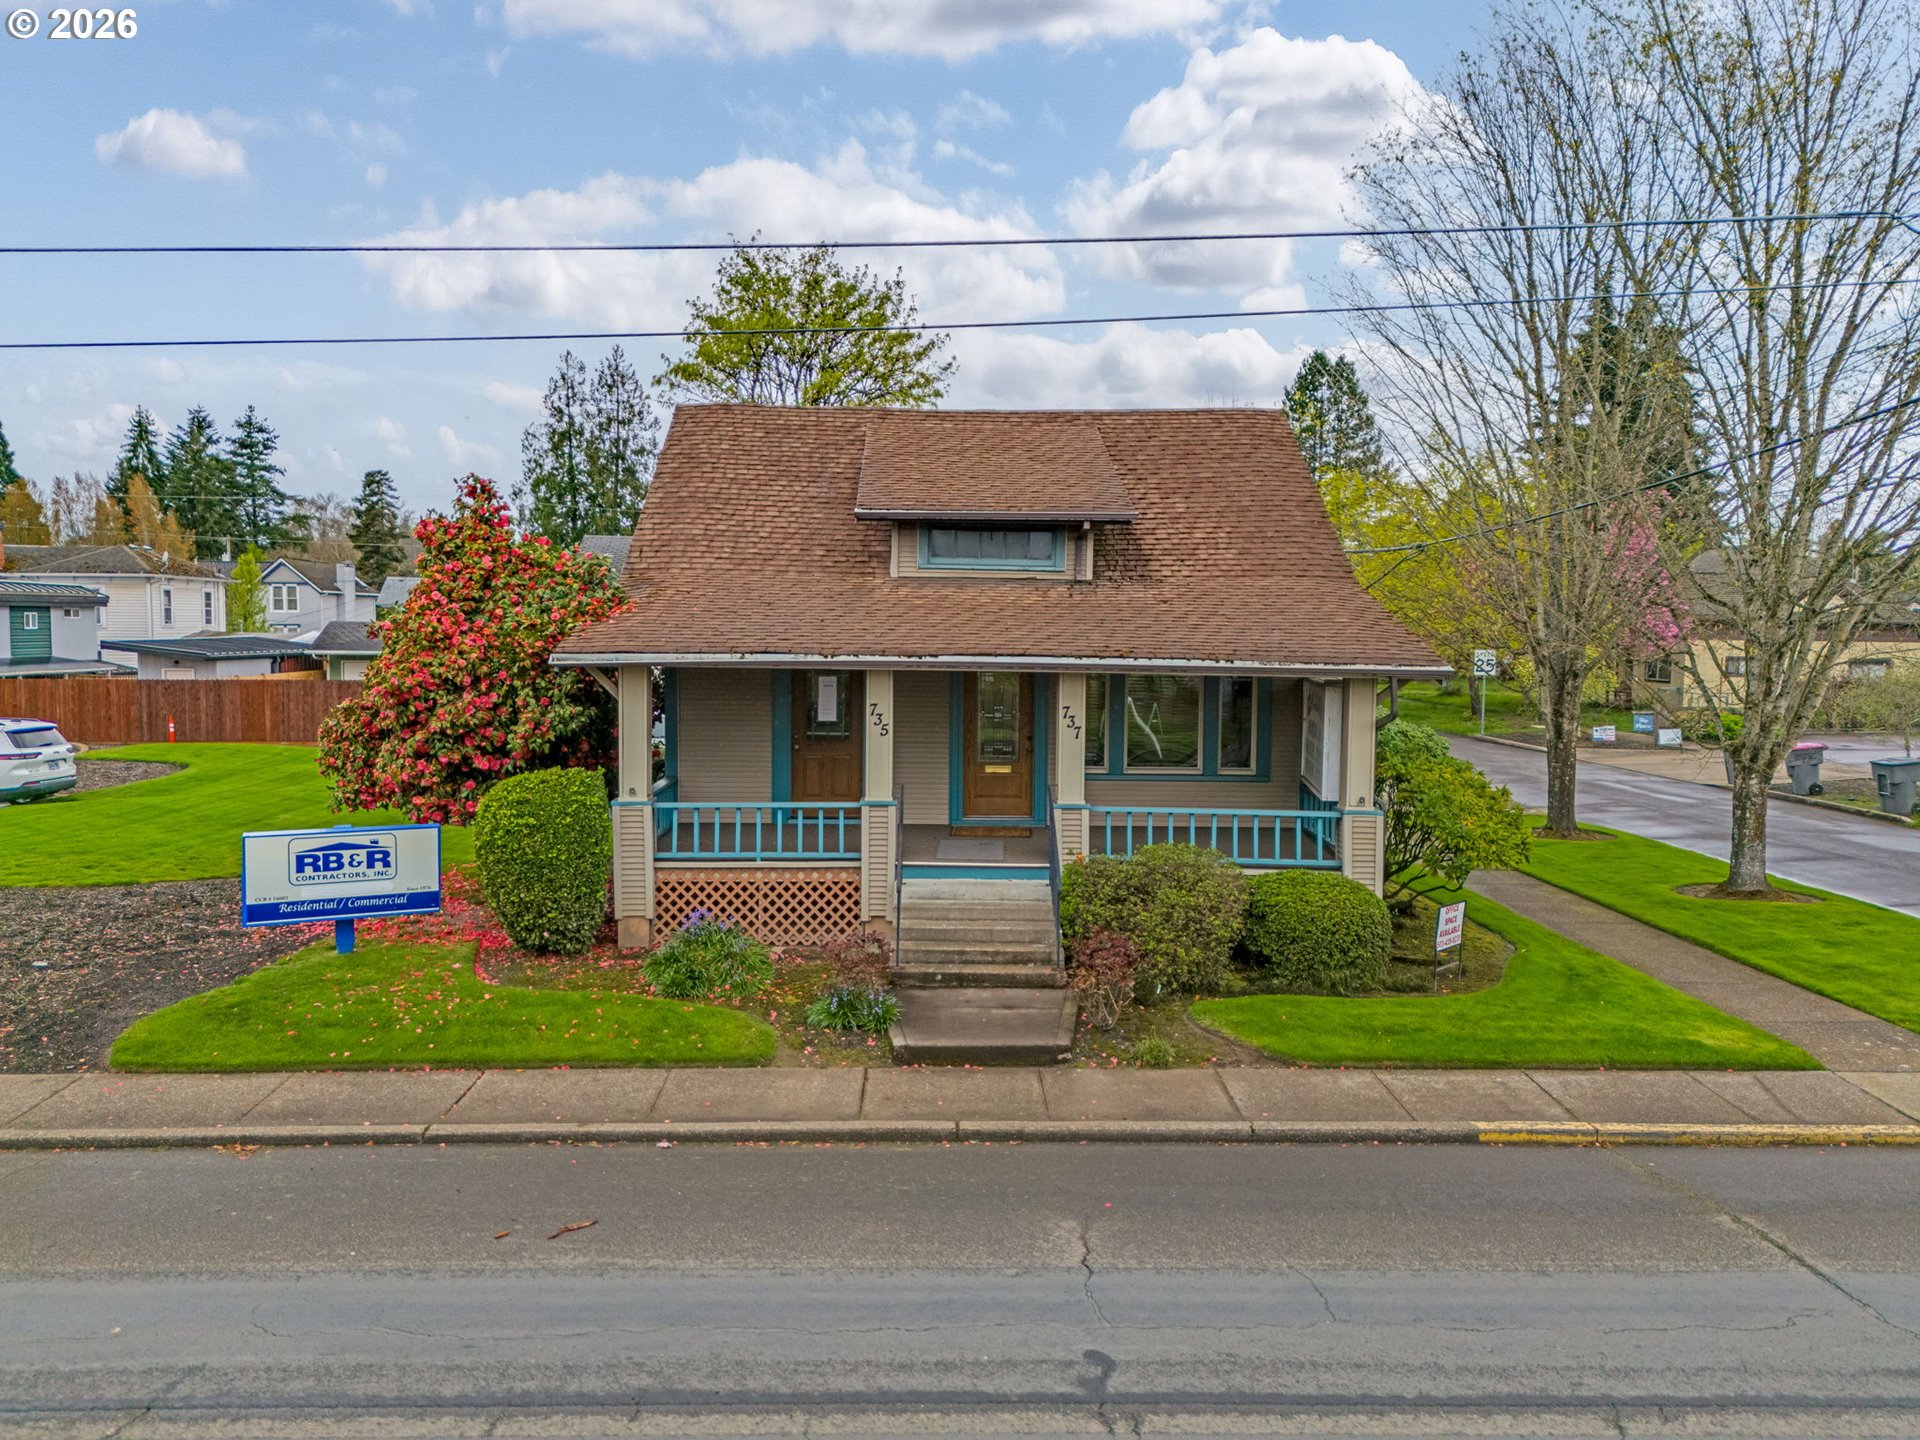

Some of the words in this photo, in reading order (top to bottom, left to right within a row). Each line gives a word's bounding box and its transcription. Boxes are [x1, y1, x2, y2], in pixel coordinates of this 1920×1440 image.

[1476, 658, 1495, 672] 25
[869, 703, 889, 736] 735
[1062, 705, 1082, 739] 737
[295, 871, 370, 882] CONTRACTORS,
[278, 899, 339, 913] Residential
[338, 898, 346, 910] /
[347, 893, 409, 907] Commercial
[1445, 904, 1459, 914] OFFICE
[1444, 915, 1457, 926] SPACE
[1439, 924, 1460, 937] AVAILABLE
